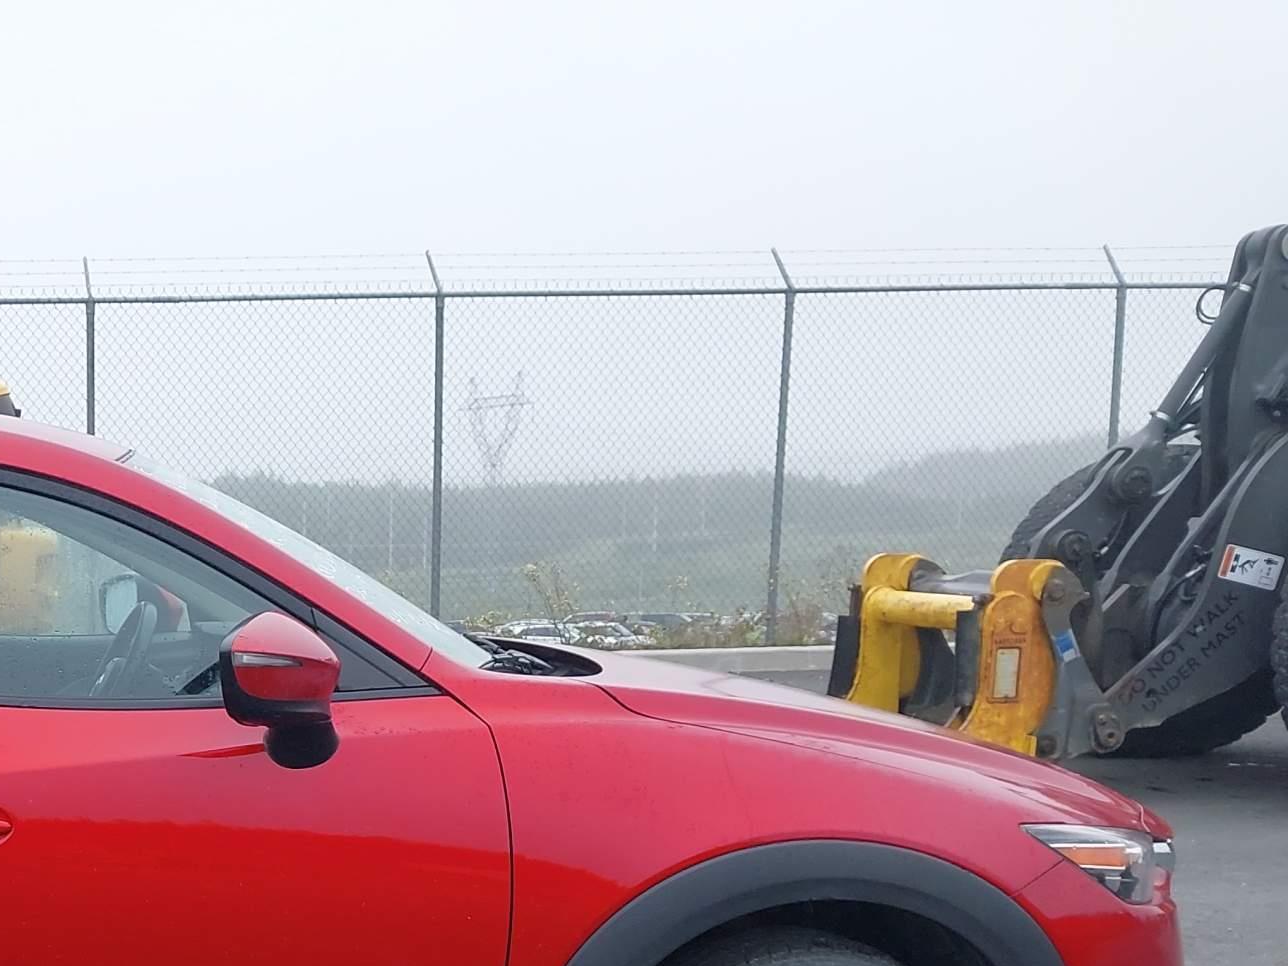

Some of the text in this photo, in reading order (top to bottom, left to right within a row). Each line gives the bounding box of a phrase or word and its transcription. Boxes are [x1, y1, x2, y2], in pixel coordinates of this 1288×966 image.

[1142, 612, 1245, 713] UNDER MAST
[1146, 639, 1185, 679] NOT
[1186, 591, 1239, 638] WALK
